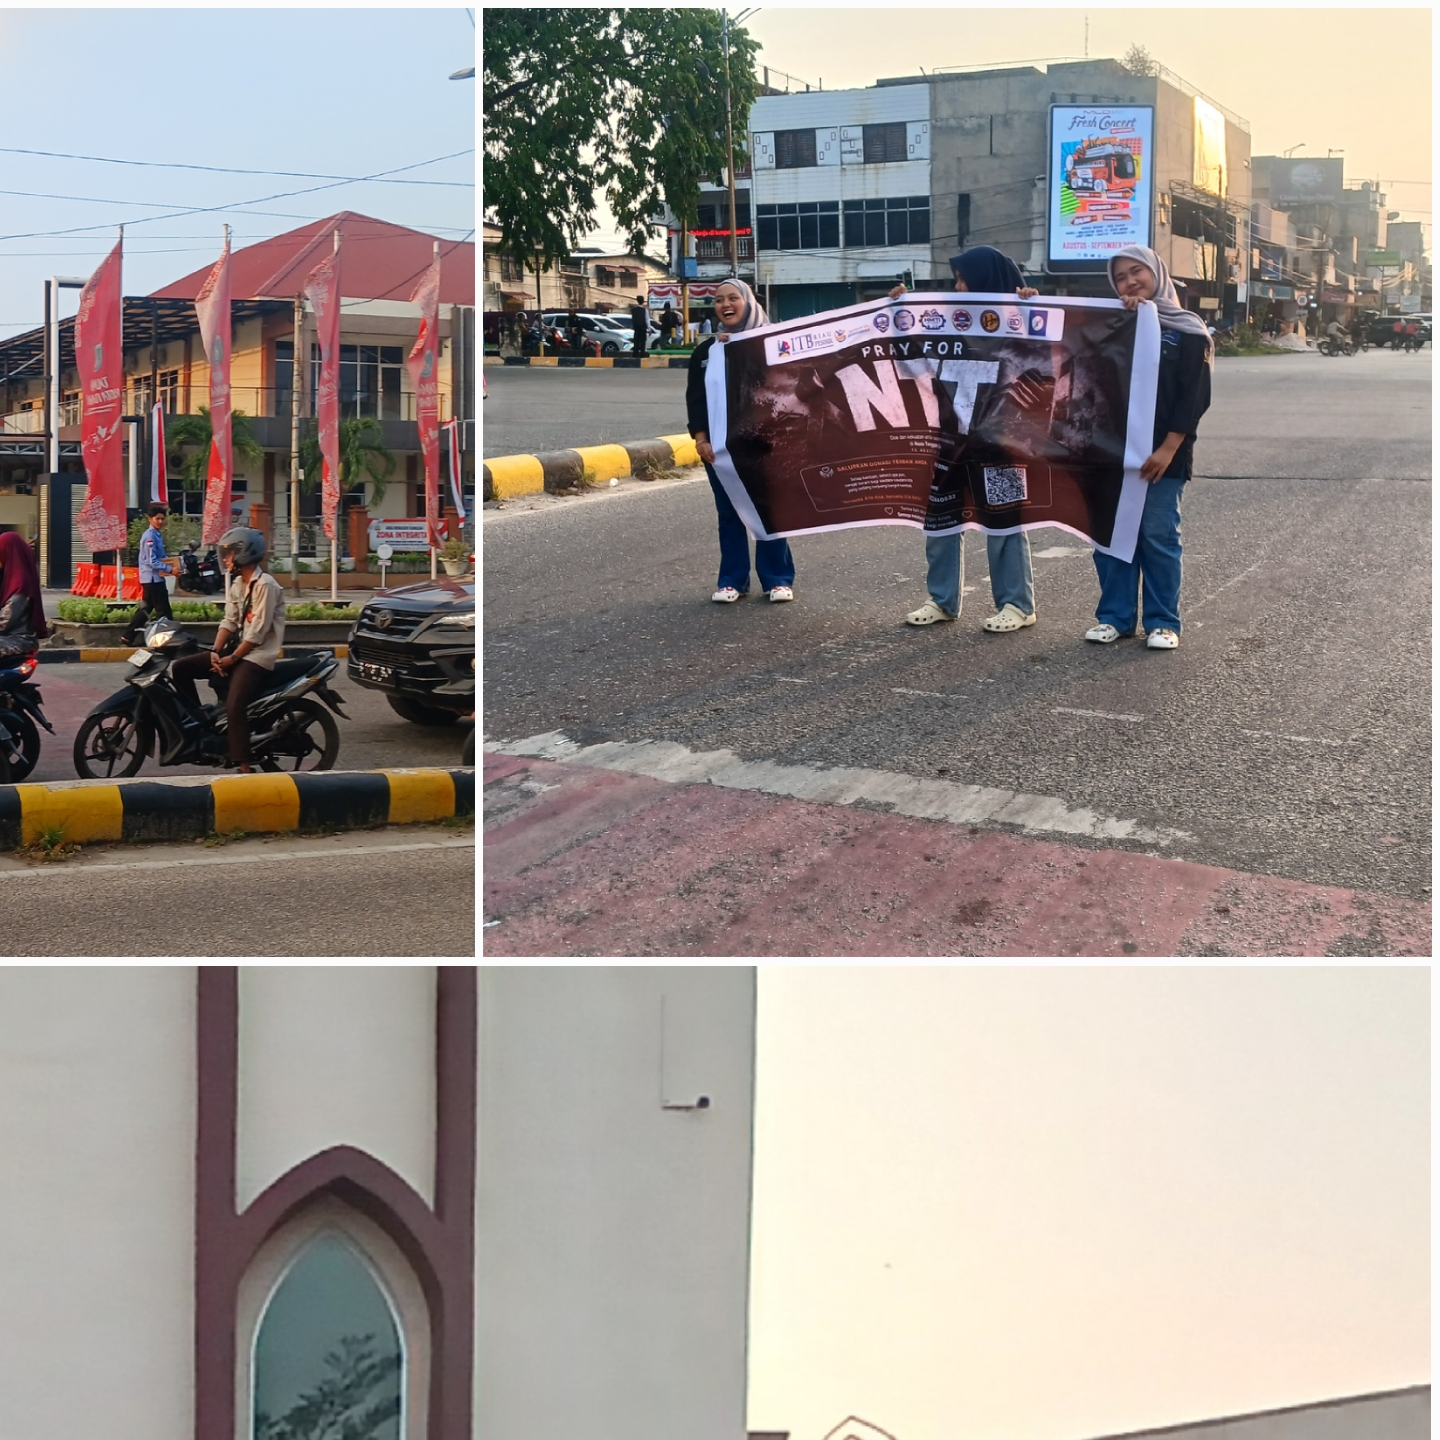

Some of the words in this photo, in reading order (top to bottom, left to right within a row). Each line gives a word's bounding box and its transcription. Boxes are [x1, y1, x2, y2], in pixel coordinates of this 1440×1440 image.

[1067, 115, 1098, 131] Fresh
[1098, 115, 1137, 131] Concert
[1062, 241, 1087, 249] AGUSTUS
[1091, 241, 1122, 249] SEPTEMBER
[790, 333, 814, 352] ITB
[861, 342, 910, 358] PRAY
[922, 341, 964, 356] FOR
[834, 357, 1000, 436] NTT
